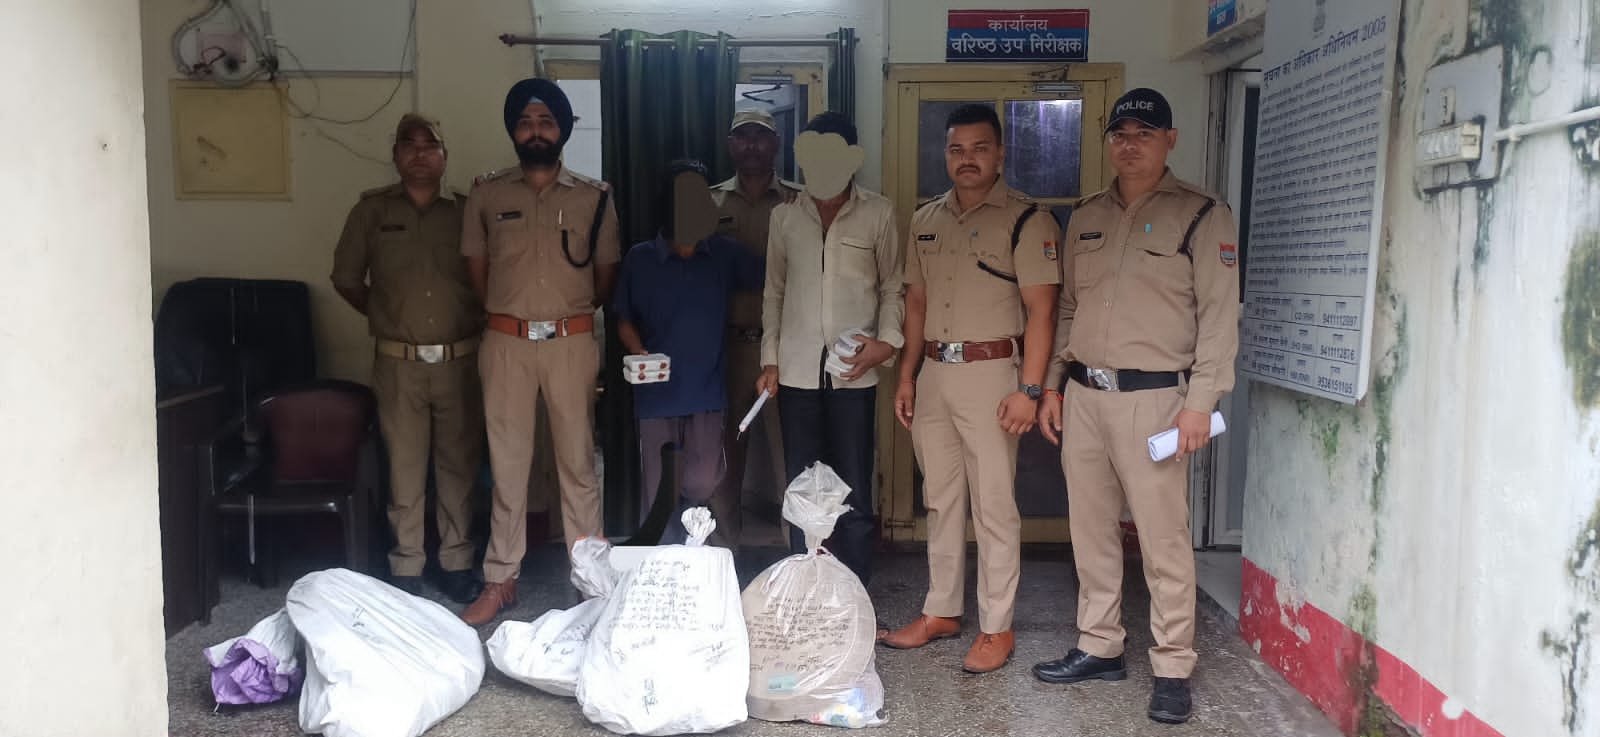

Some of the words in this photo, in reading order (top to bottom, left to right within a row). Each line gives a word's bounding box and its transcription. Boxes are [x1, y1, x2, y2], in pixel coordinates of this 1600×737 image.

[987, 15, 1048, 32] कार्यालय
[950, 33, 997, 53] वरिष्ठ
[1000, 38, 1026, 53] उप
[1029, 33, 1082, 53] निरीक्षक
[1264, 66, 1281, 88] सूचना
[1283, 62, 1291, 75] का
[1293, 49, 1320, 70] अधिकार
[1322, 29, 1359, 57] अधिनियम
[1361, 16, 1386, 41] 2005
[1116, 100, 1154, 114] POLICE
